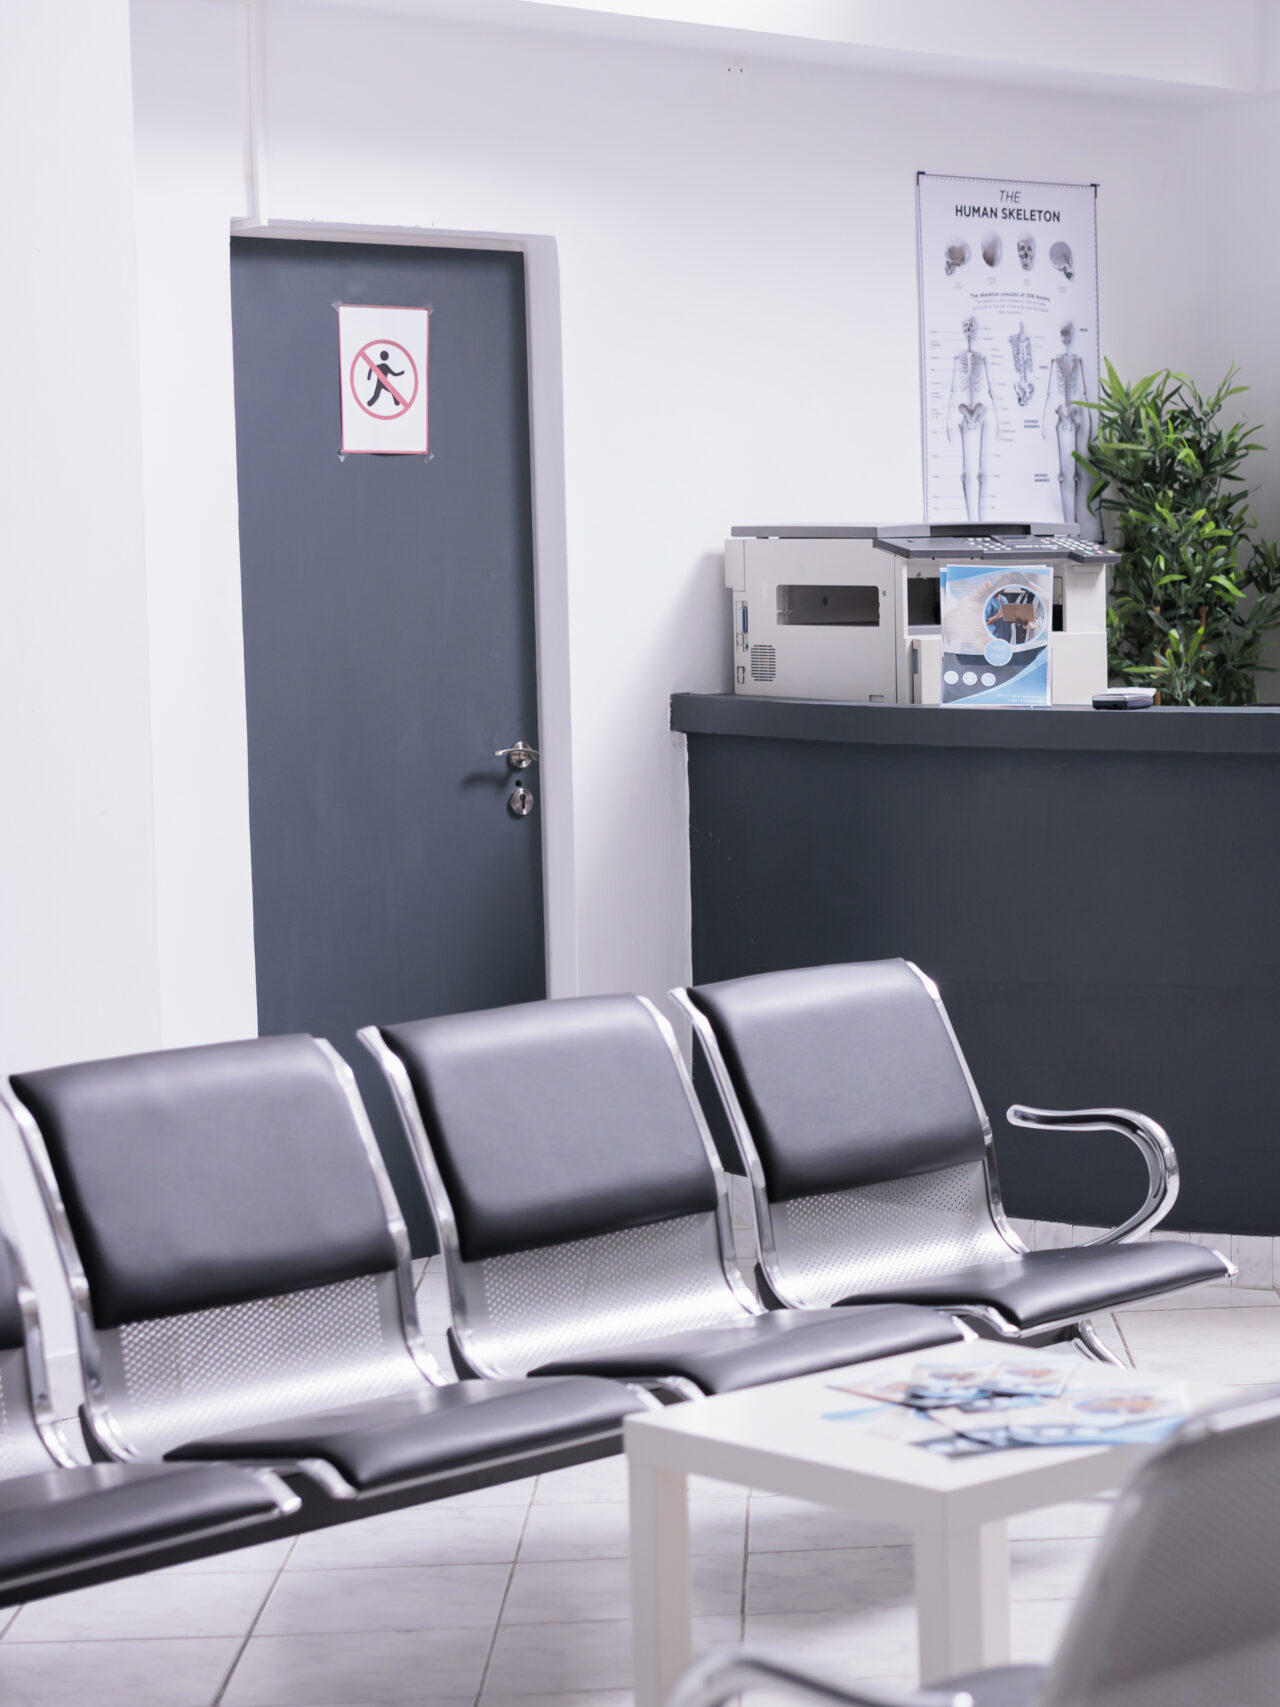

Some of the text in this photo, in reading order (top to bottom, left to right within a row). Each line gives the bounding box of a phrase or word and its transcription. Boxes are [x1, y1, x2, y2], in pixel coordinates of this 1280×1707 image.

[1000, 190, 1021, 203] THE
[955, 205, 1061, 222] HUMAN SKELETON
